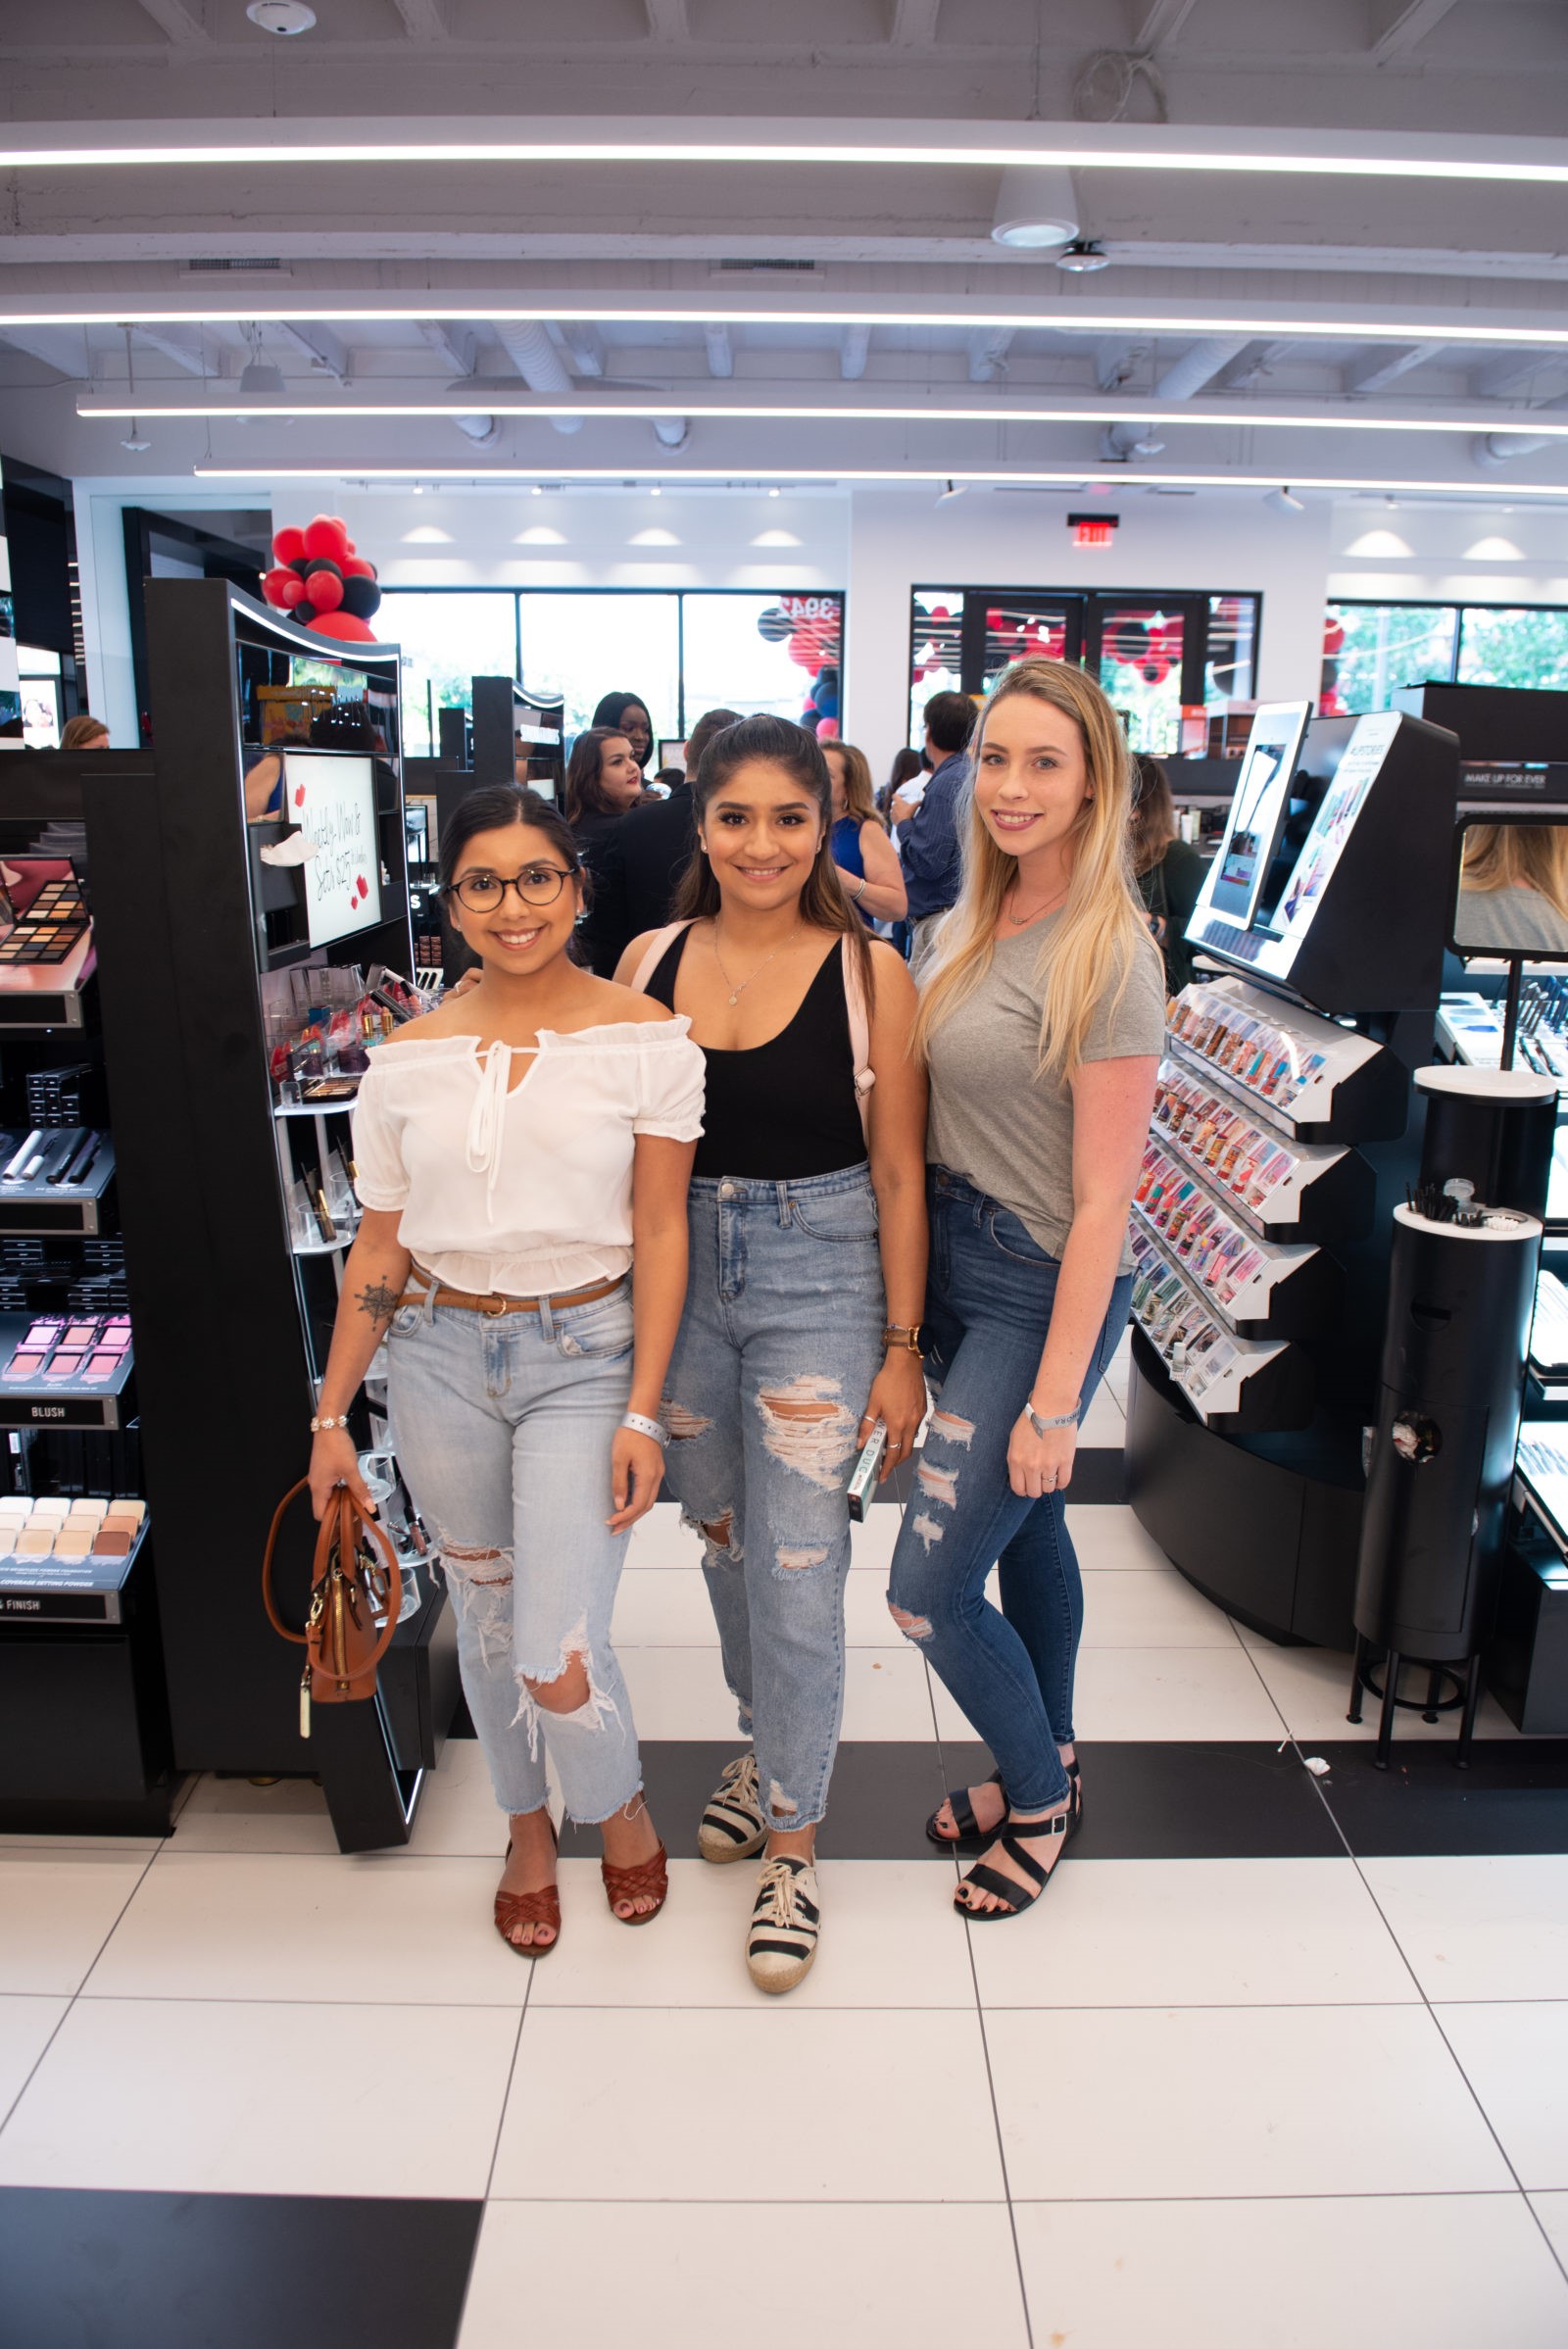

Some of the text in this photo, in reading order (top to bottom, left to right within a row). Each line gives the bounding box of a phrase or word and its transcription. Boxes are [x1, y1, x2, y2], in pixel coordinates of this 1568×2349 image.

[1465, 773, 1546, 785] MAKE UP FOR EVER
[30, 1406, 66, 1418] BLUSH
[6, 1599, 41, 1611] FINISH
